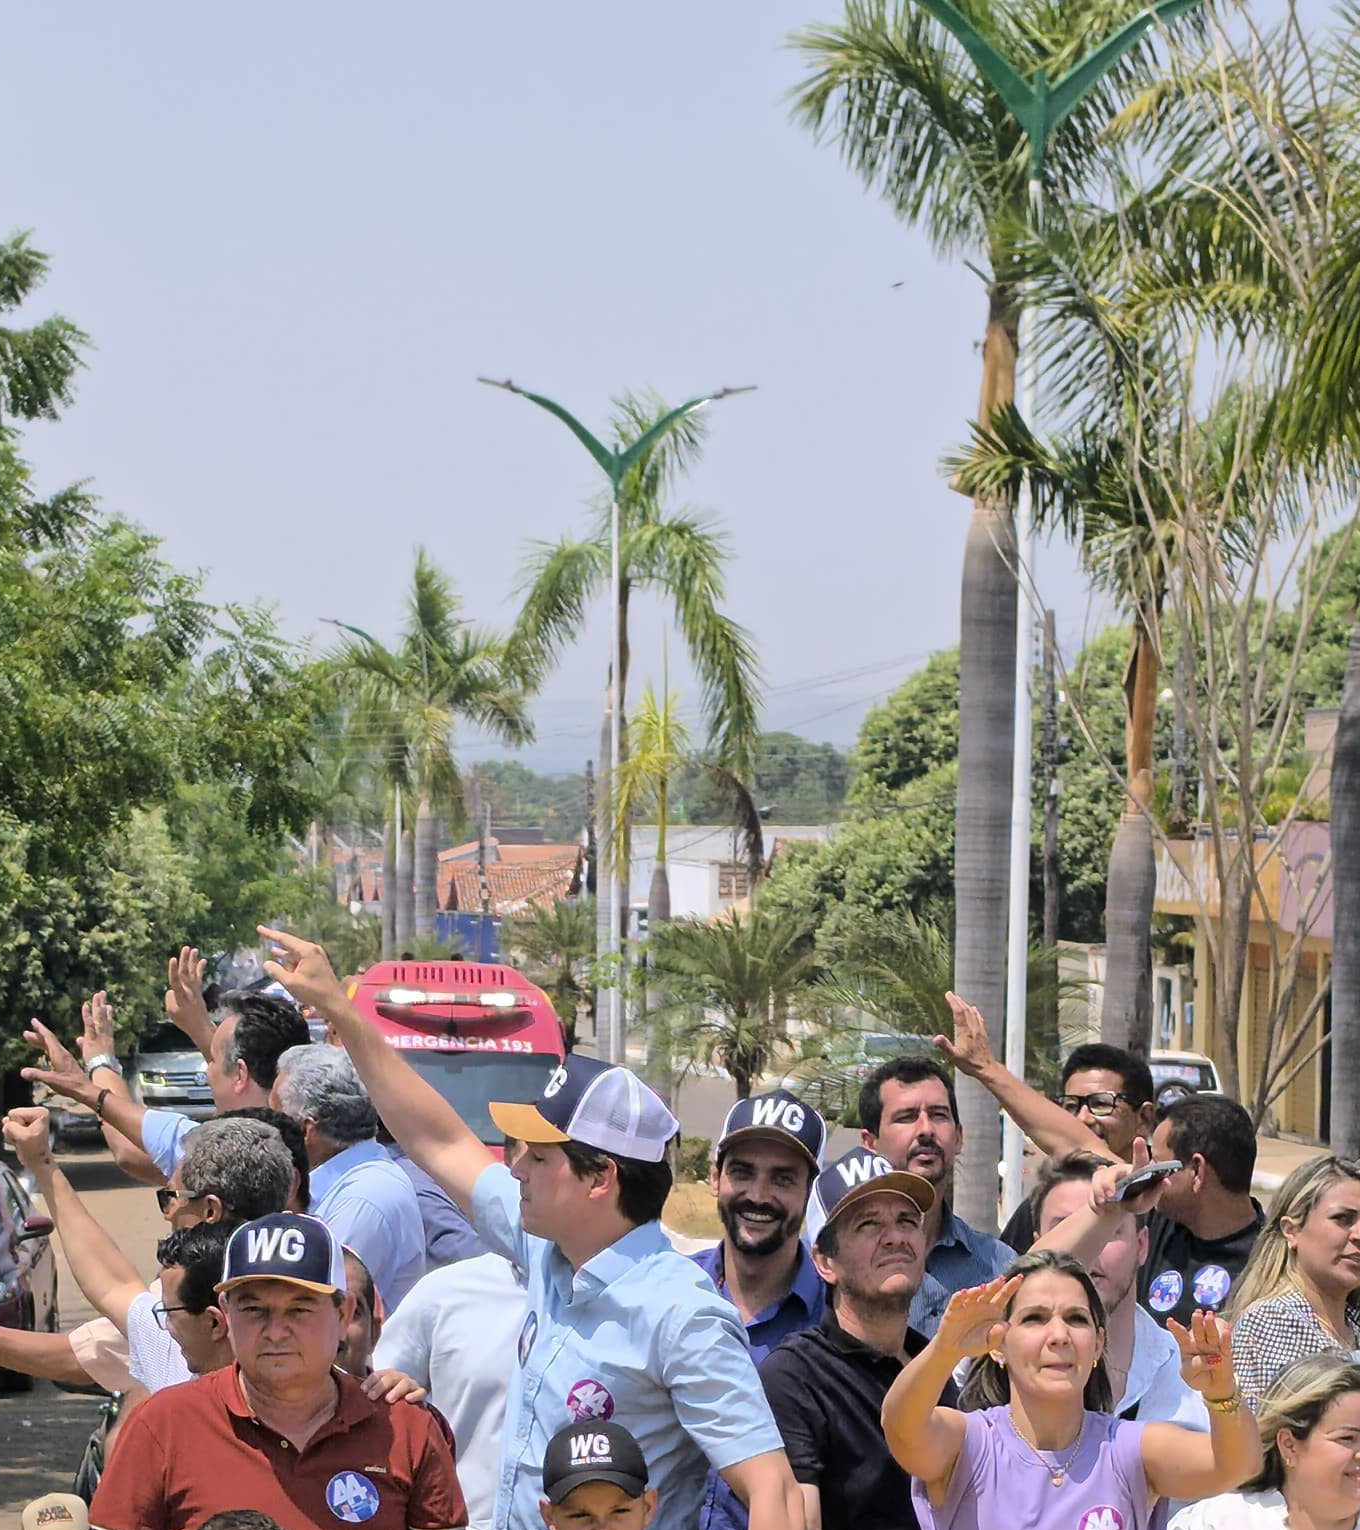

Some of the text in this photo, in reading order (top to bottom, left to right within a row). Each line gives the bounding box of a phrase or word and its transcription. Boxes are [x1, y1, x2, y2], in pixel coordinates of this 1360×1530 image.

[384, 1033, 533, 1053] MERGÊNCIA 193
[752, 1098, 806, 1132] WG
[247, 1228, 306, 1262] WG
[570, 1433, 610, 1459] WG
[334, 1474, 368, 1509] 44
